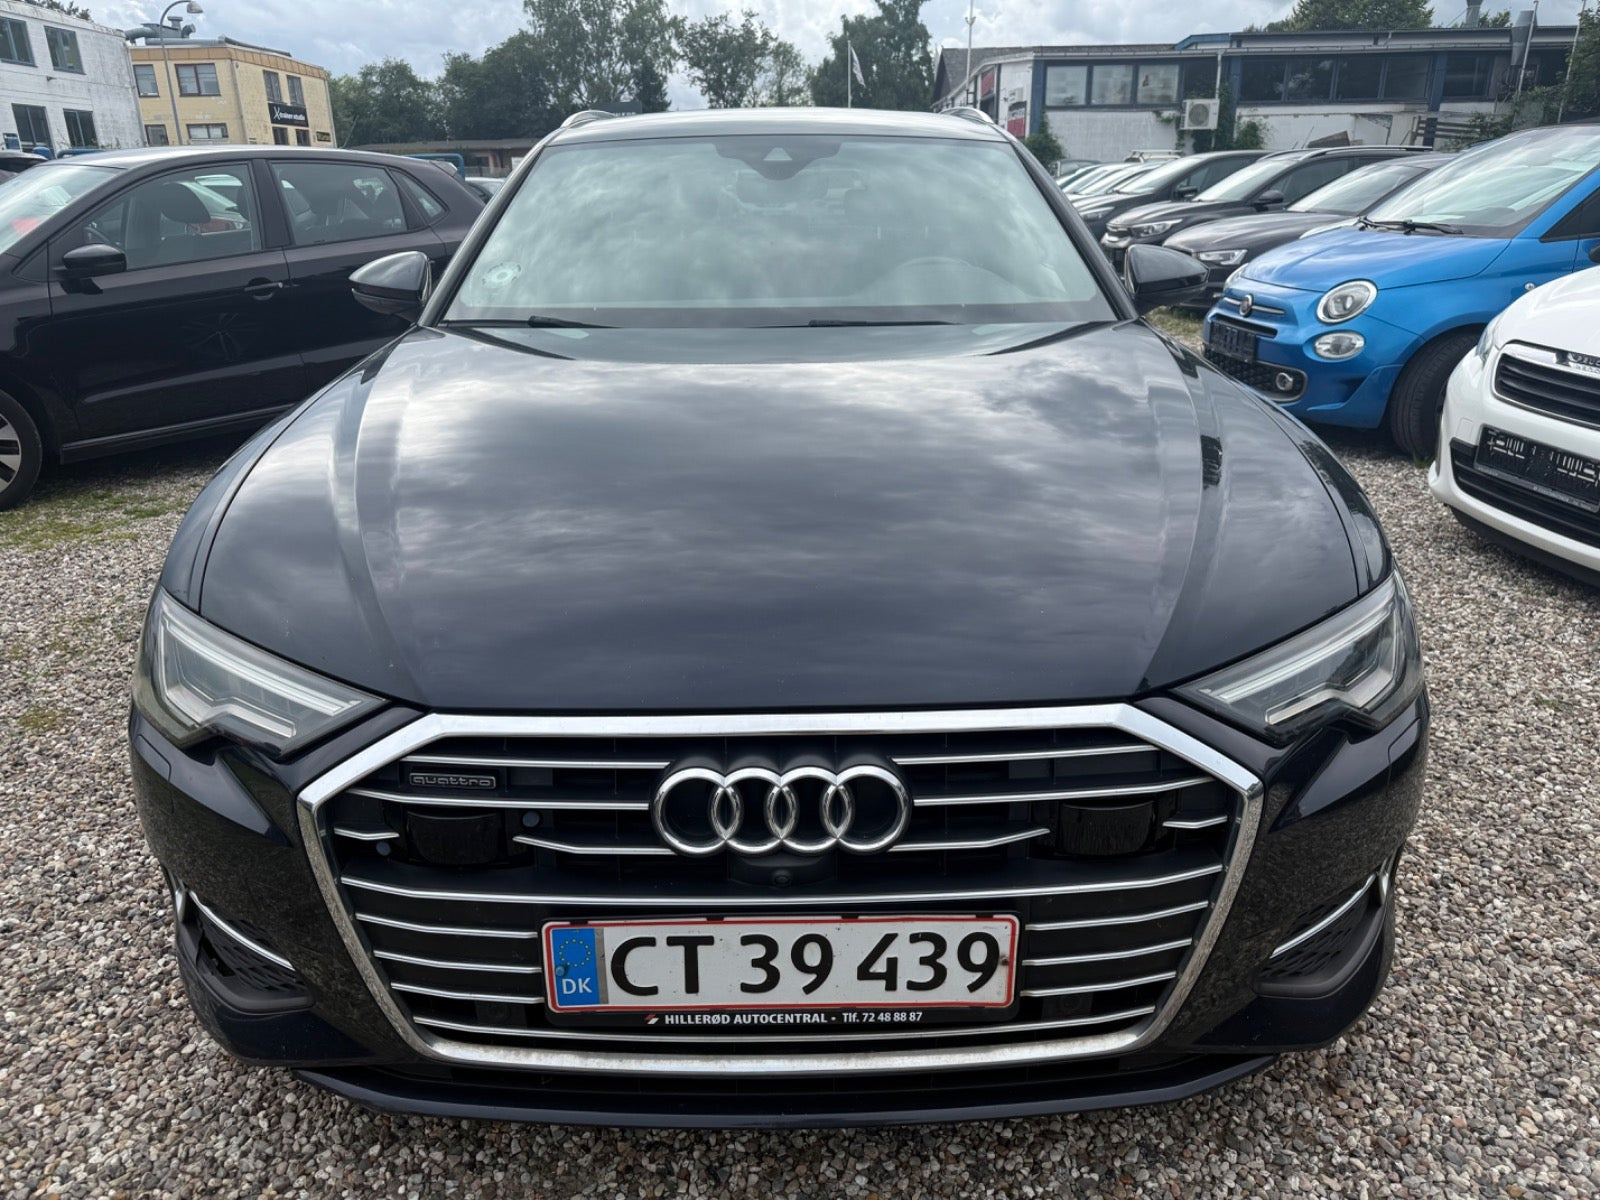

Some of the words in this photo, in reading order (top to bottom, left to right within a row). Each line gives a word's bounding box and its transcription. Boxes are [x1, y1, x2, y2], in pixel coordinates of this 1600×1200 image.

[413, 776, 491, 786] quattro
[611, 936, 715, 996] CT
[740, 933, 834, 995] 39
[857, 931, 1000, 993] 439
[562, 978, 592, 995] DK
[665, 1014, 730, 1024] HILLERØD
[734, 1013, 828, 1024] AUTOCENTRAL
[842, 1012, 860, 1023] Tlf.
[862, 1012, 875, 1022] 72
[877, 1012, 892, 1022] 48
[893, 1012, 907, 1022] 88
[909, 1012, 922, 1022] 87
